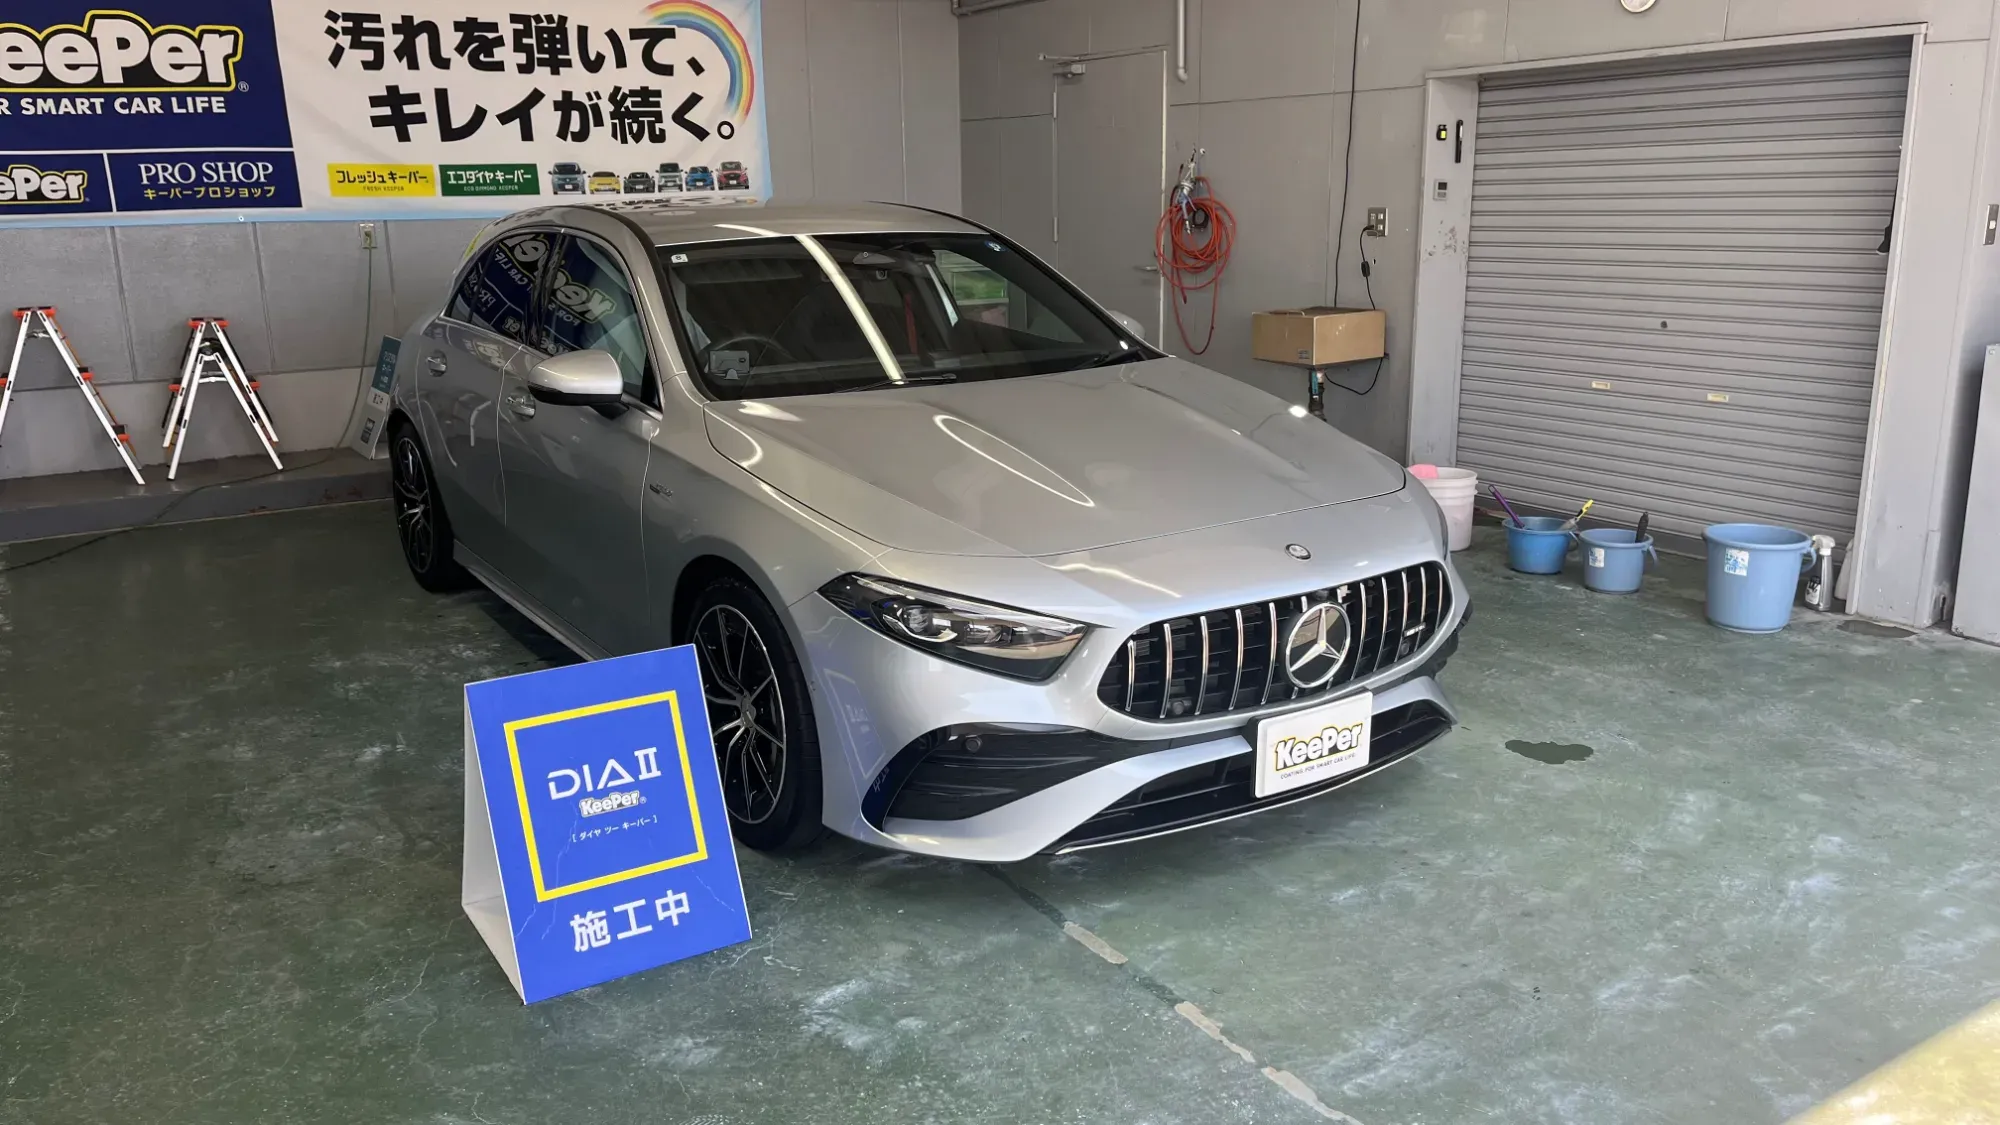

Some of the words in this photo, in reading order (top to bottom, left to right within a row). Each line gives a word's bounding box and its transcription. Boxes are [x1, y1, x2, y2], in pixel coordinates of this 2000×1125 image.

[0, 17, 237, 86] eePer
[323, 8, 706, 77] 汚れを弾いて、
[20, 97, 105, 115] SMART
[113, 96, 164, 115] CAR
[171, 96, 226, 114] LIFE
[368, 84, 735, 145] キレイが続く。
[0, 167, 84, 201] ePer
[138, 162, 197, 185] PRO
[201, 161, 274, 183] SHOP
[143, 185, 276, 200] キーパープロショップ
[1275, 723, 1363, 771] KeePer
[580, 791, 639, 817] KeePer
[569, 889, 691, 952] 施工中
